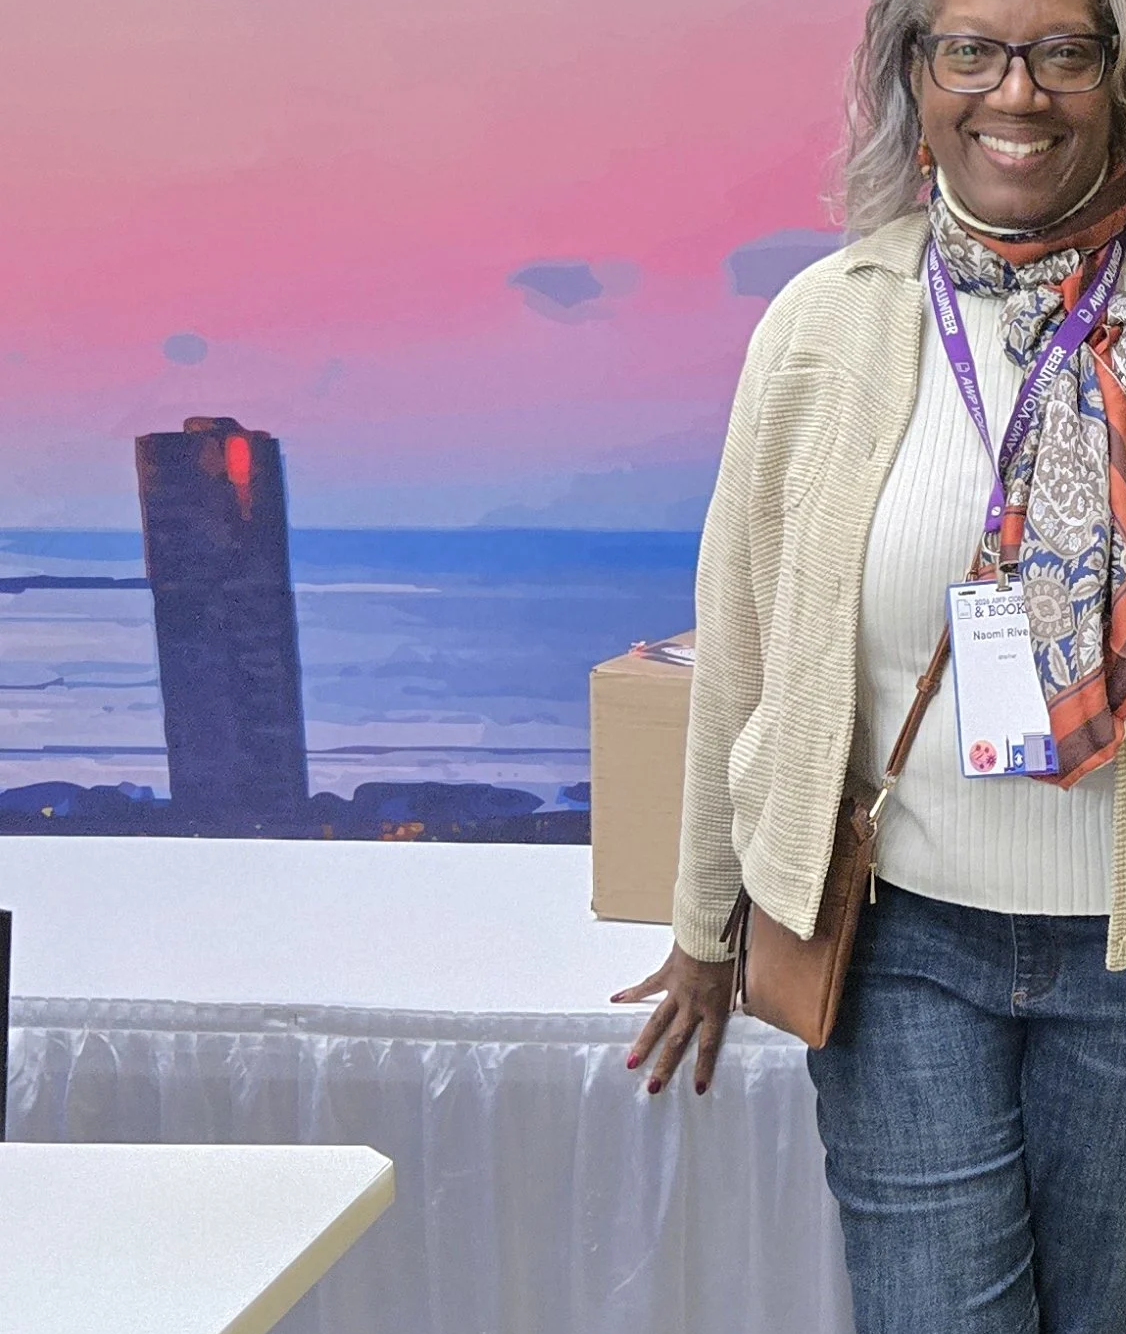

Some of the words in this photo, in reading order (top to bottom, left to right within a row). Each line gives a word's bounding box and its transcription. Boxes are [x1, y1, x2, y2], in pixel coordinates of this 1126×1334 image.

[932, 270, 959, 336] VOLUNTEER
[1089, 283, 1107, 312] AWP
[960, 376, 979, 405] AWP
[1006, 421, 1024, 453] AWP
[1018, 346, 1067, 420] VOLUNTEER
[975, 606, 984, 618] &
[973, 628, 1004, 641] Naomi
